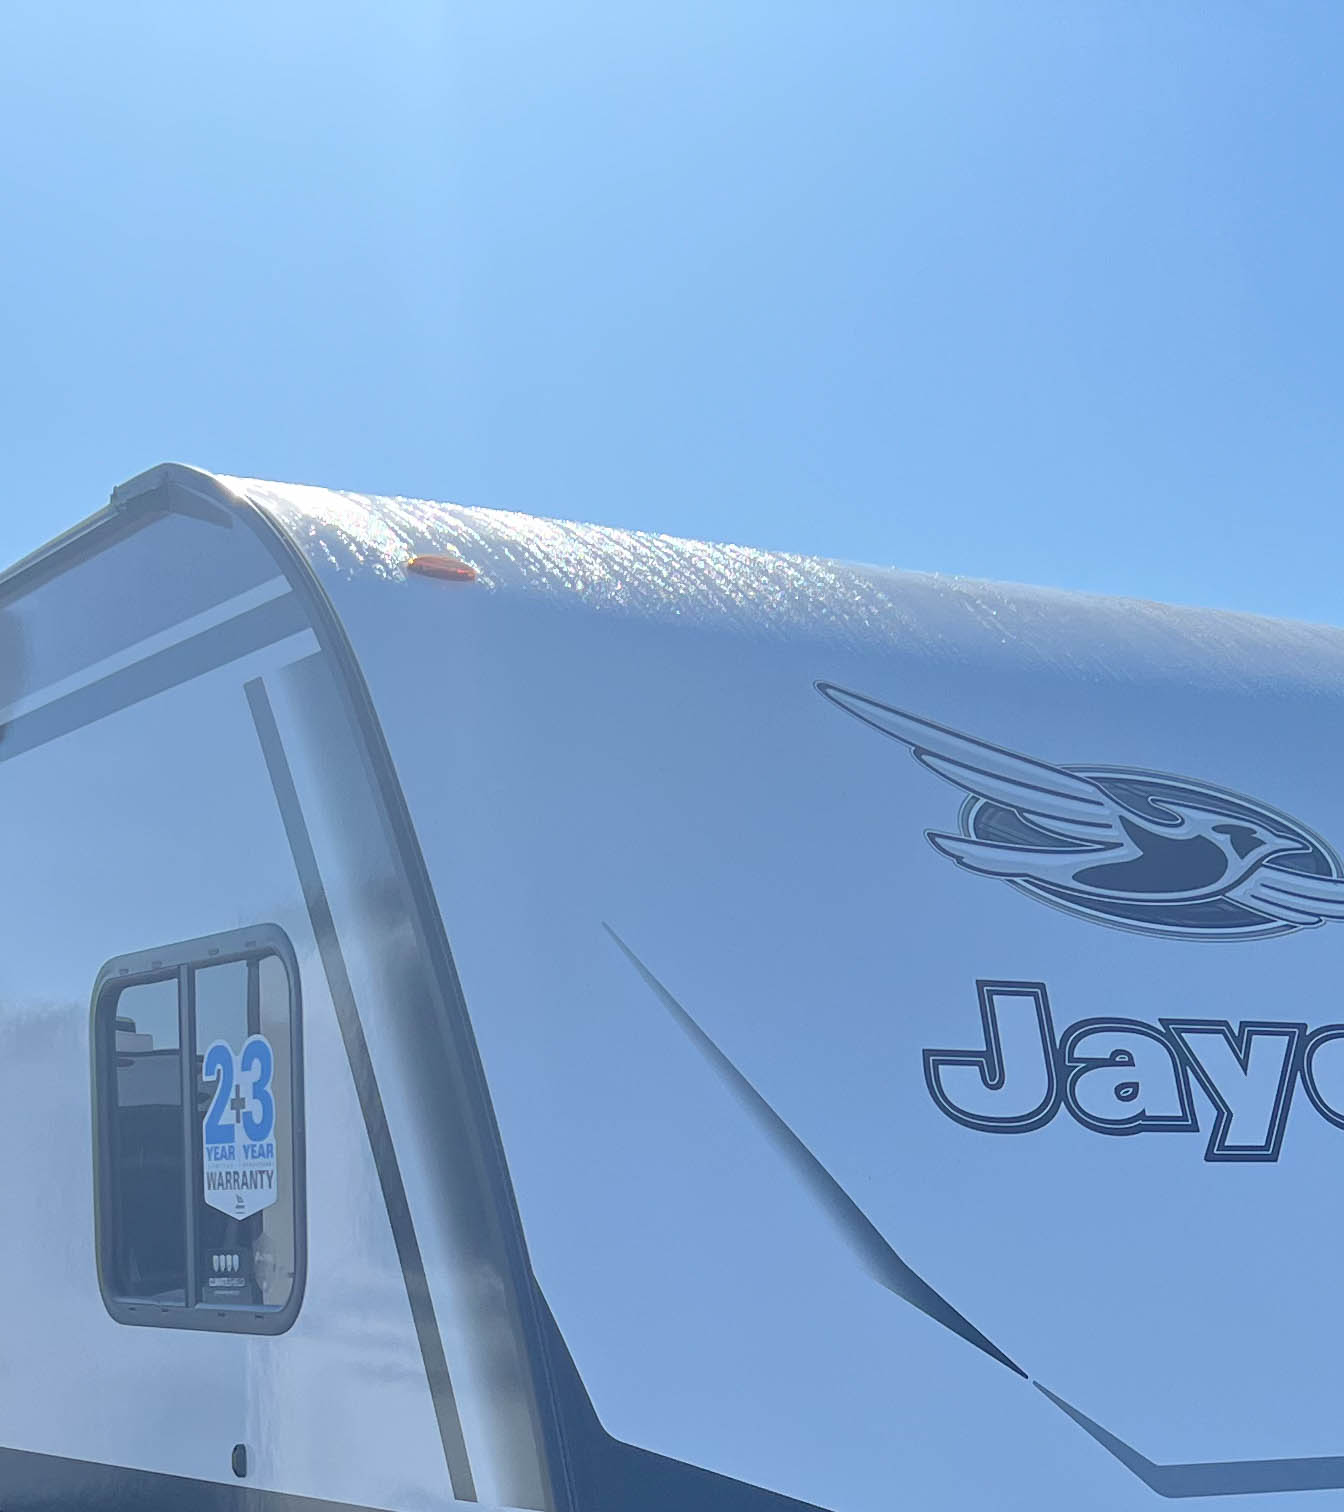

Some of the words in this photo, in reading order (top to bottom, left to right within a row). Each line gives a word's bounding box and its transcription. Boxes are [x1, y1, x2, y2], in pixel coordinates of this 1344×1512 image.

[206, 1144, 236, 1161] YEAR
[242, 1143, 274, 1160] YEAR
[206, 1170, 274, 1191] WARRANTY
